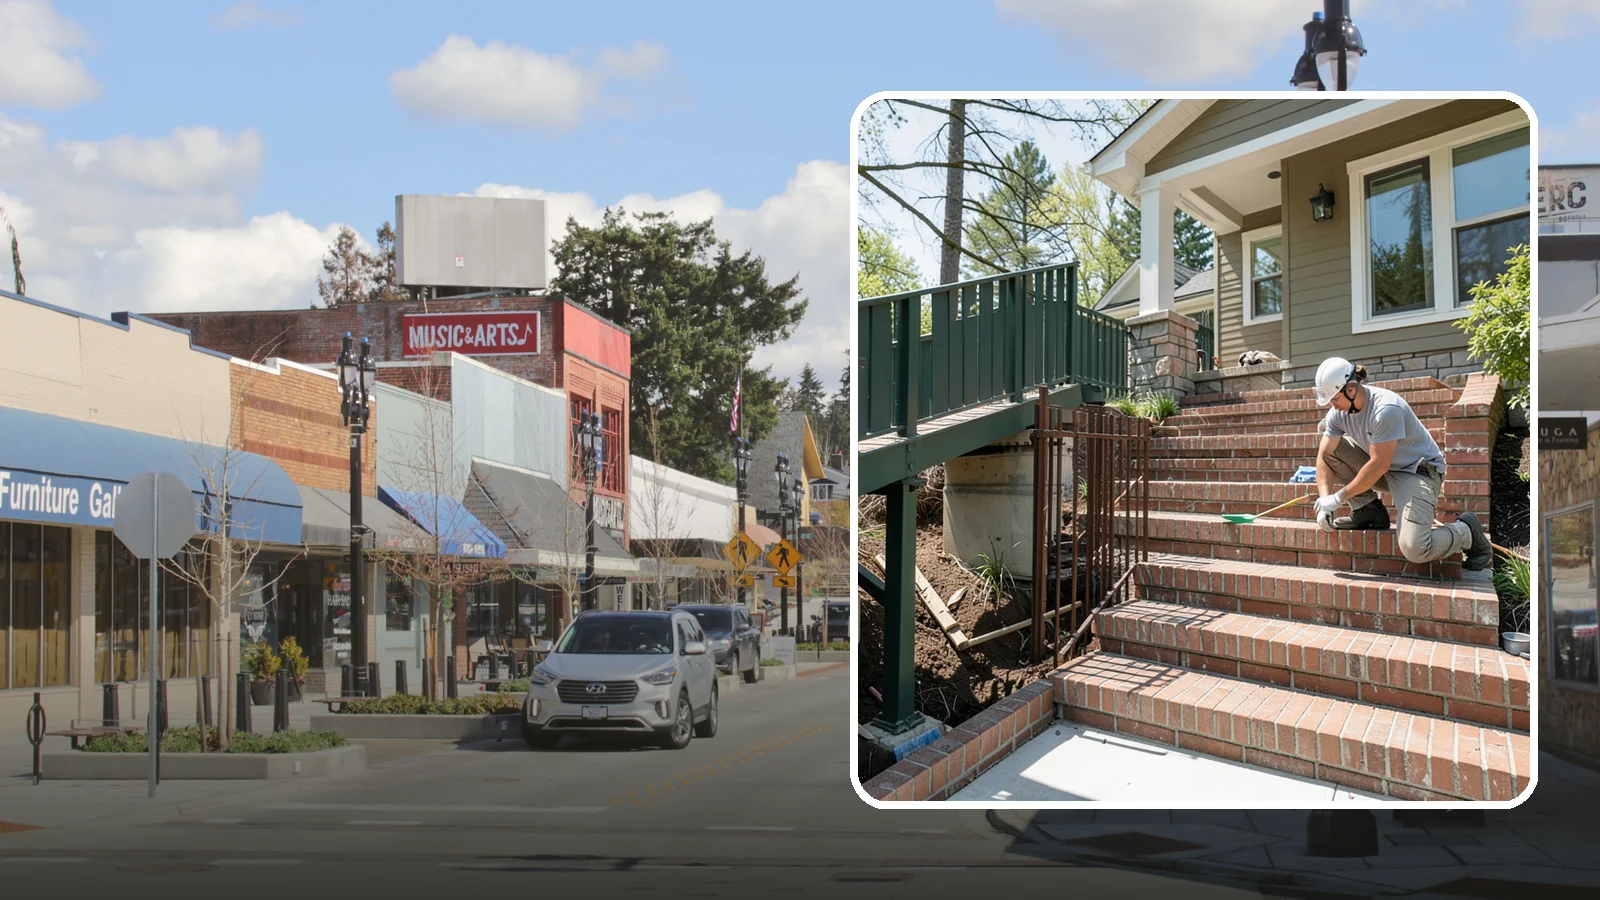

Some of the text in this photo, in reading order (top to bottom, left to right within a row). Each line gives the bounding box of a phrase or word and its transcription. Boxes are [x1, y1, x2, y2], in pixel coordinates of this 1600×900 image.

[408, 323, 520, 349] MUSIC&ARTS
[0, 471, 79, 515] Furniture
[453, 563, 479, 574] SUSHI
